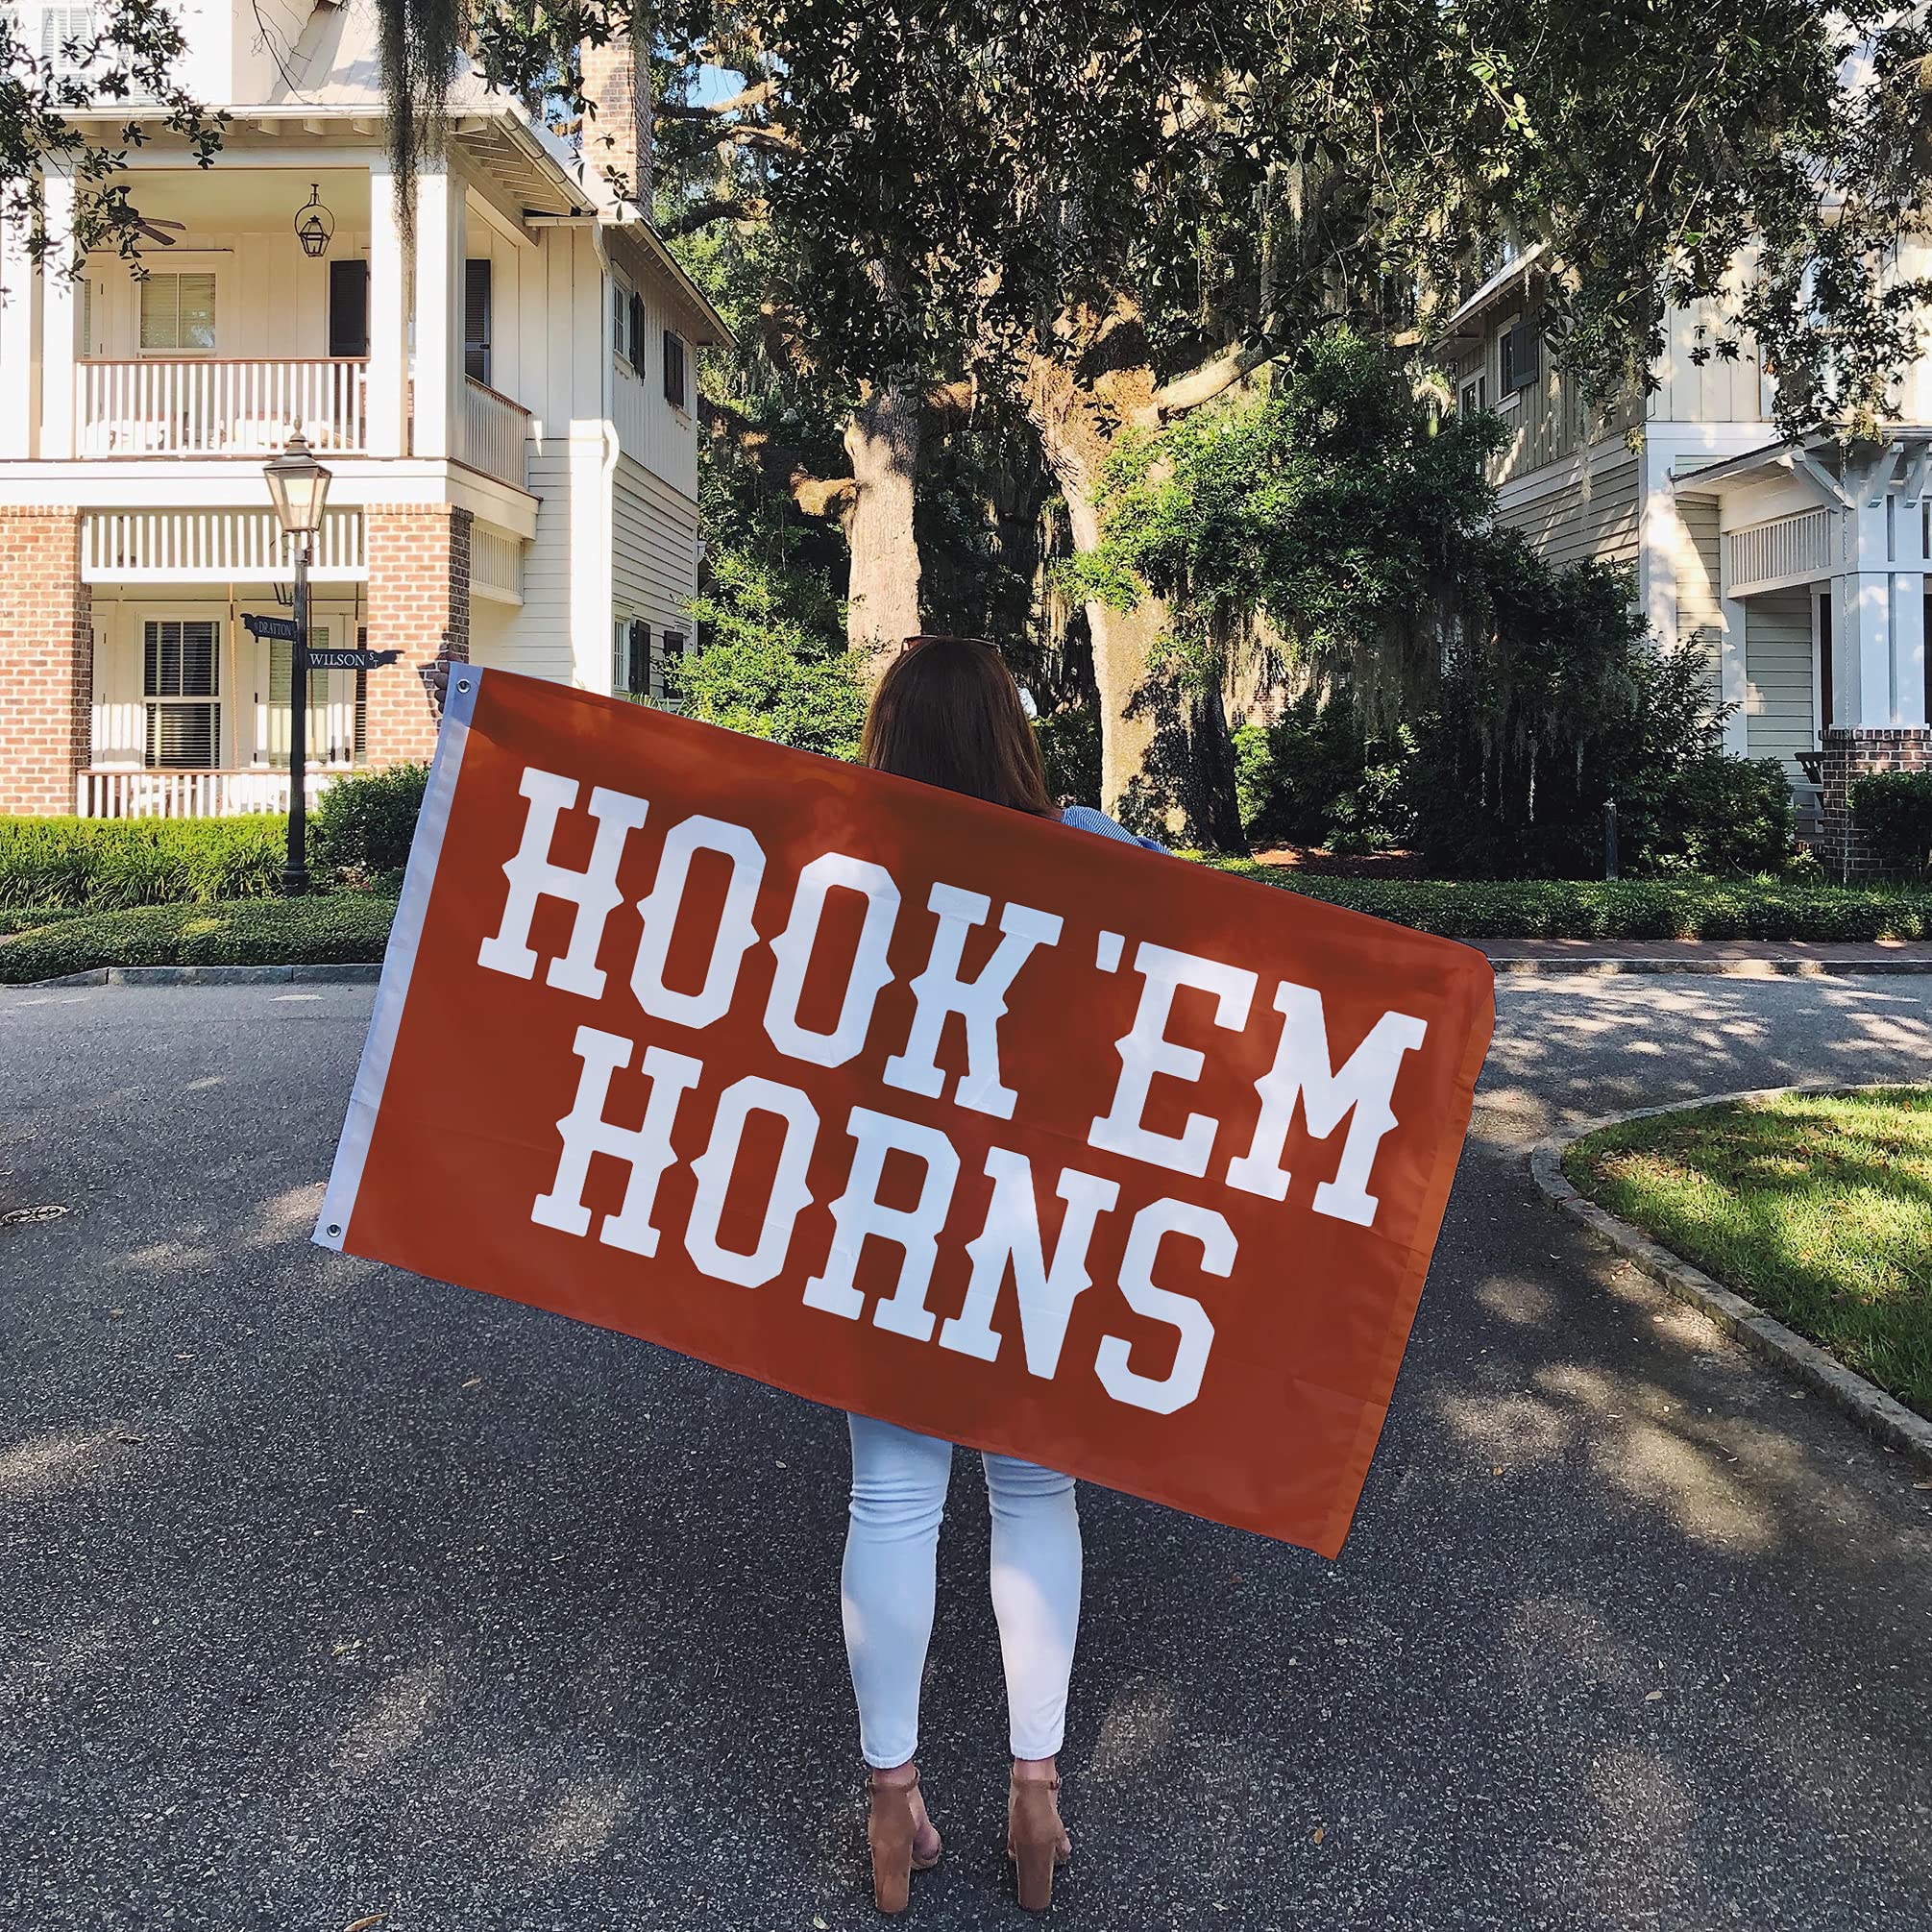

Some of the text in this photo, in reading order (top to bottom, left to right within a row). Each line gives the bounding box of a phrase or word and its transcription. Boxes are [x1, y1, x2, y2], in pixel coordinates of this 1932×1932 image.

[309, 653, 365, 667] WILSON
[477, 767, 1428, 1227] HOOK 'EM
[531, 1025, 1238, 1414] HORNS
